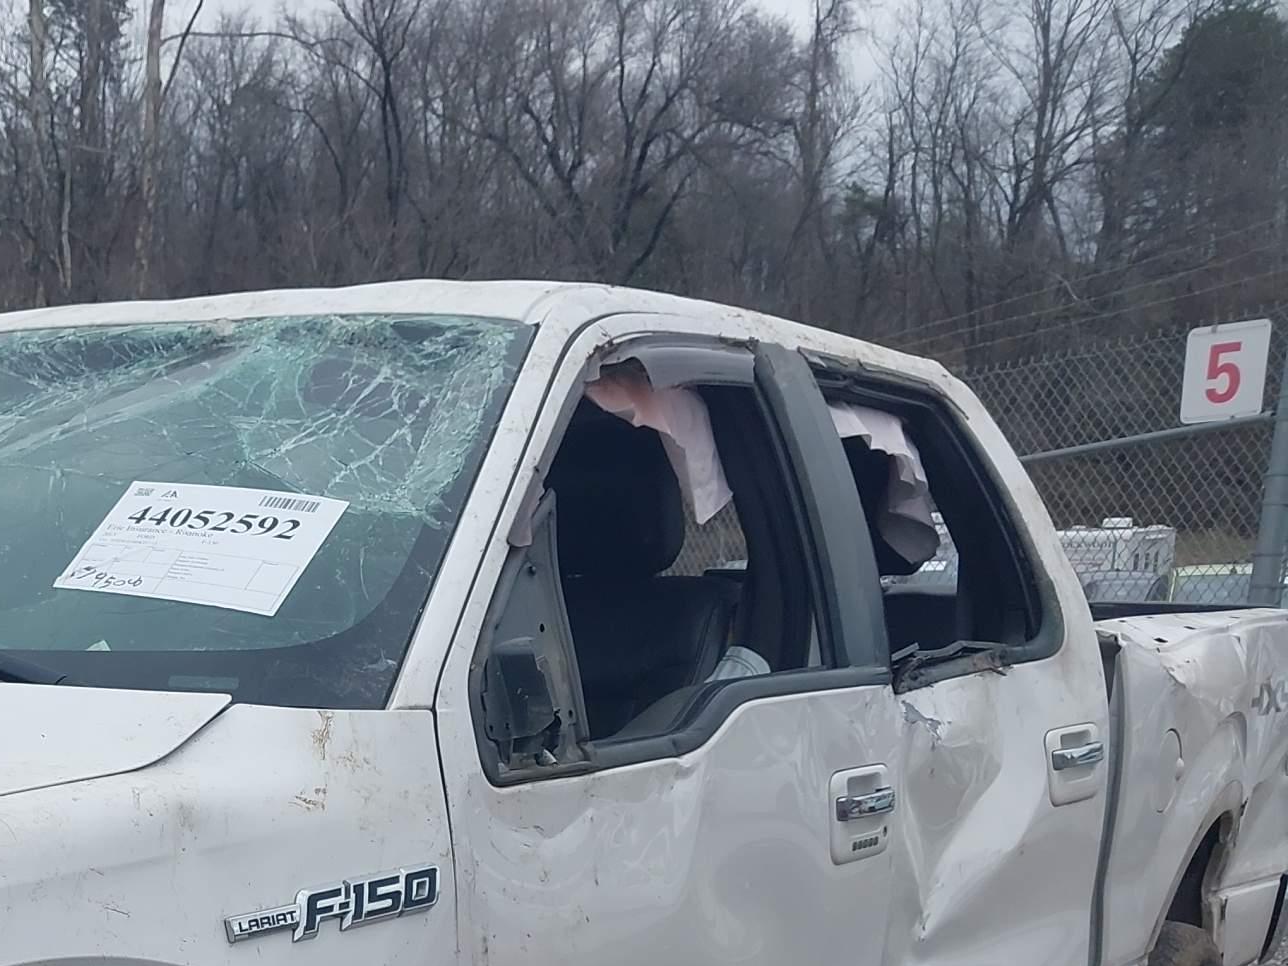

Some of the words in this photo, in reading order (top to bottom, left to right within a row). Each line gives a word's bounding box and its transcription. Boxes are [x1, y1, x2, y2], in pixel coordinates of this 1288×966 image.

[1205, 341, 1242, 404] 5
[127, 506, 301, 540] 44052592
[238, 909, 297, 933] LARIAT
[293, 864, 440, 942] F-150
